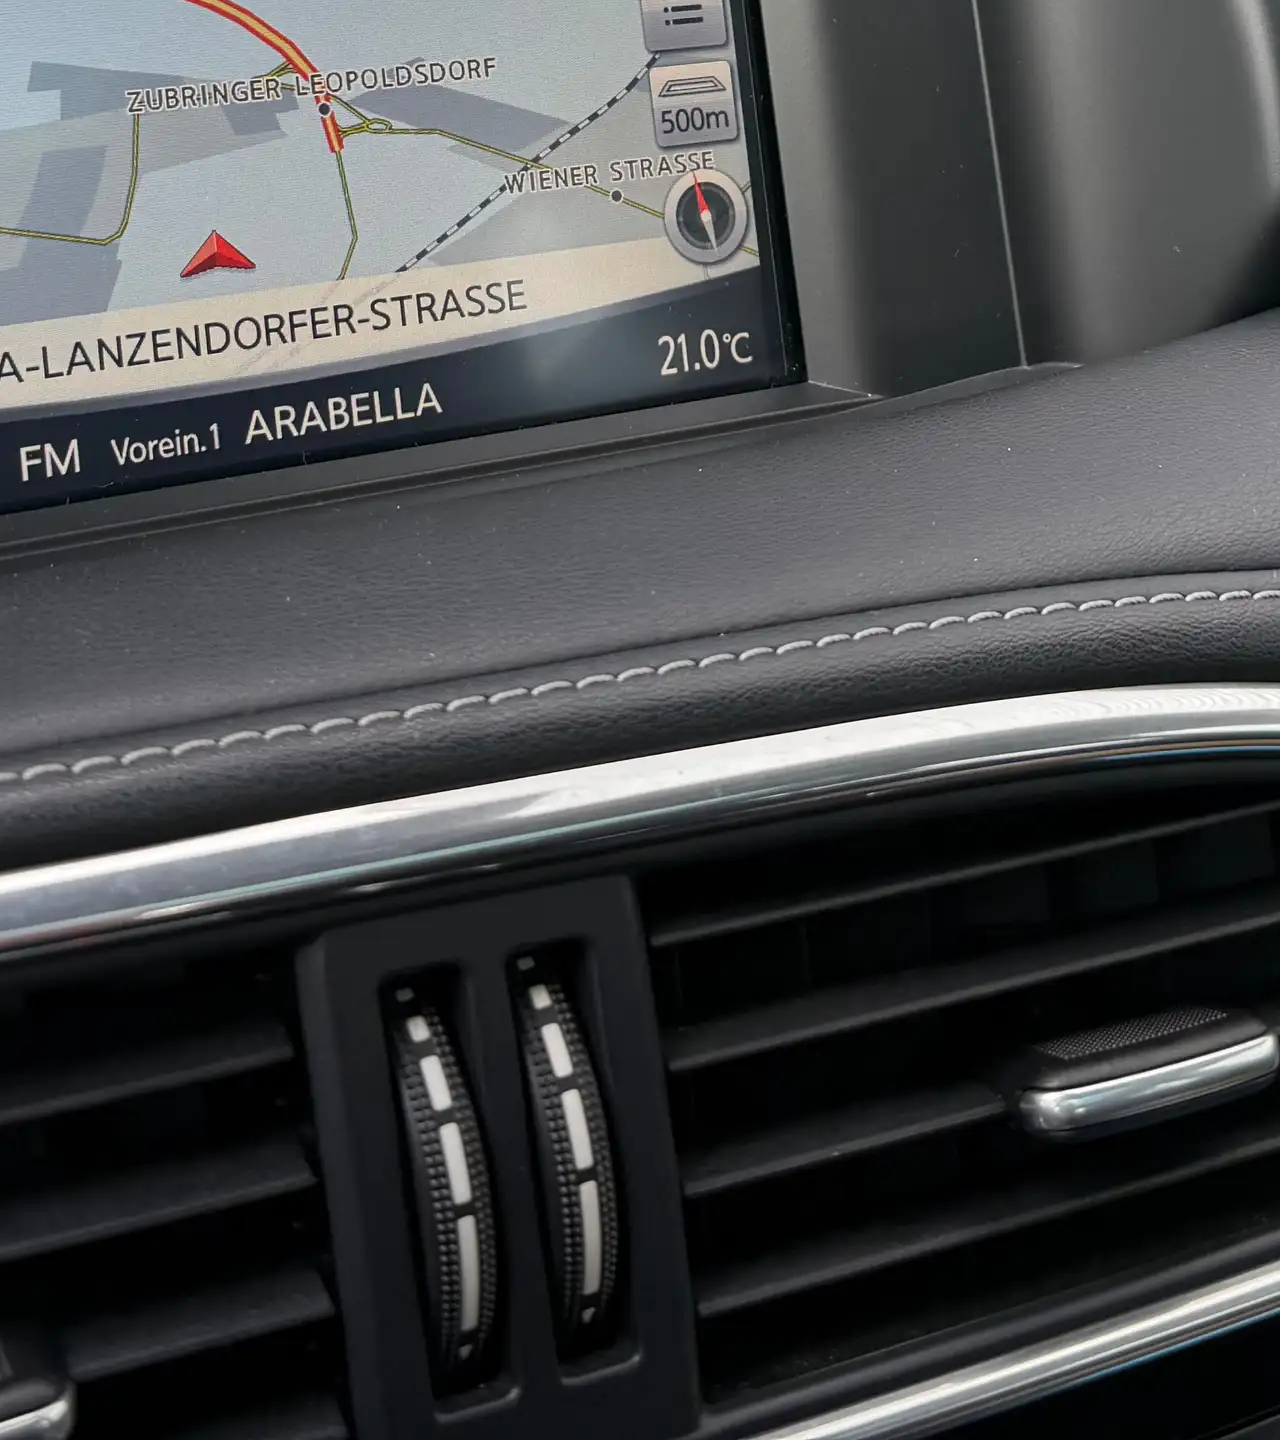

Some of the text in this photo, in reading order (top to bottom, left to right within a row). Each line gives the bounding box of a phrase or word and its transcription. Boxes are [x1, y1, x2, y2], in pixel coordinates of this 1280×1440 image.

[126, 56, 497, 114] ZUBRINGER LEOPOLDSDORF
[661, 107, 730, 136] 500m
[503, 150, 715, 195] WIENER STRASSE
[19, 438, 81, 482] FM
[245, 382, 443, 446] ARABELLA
